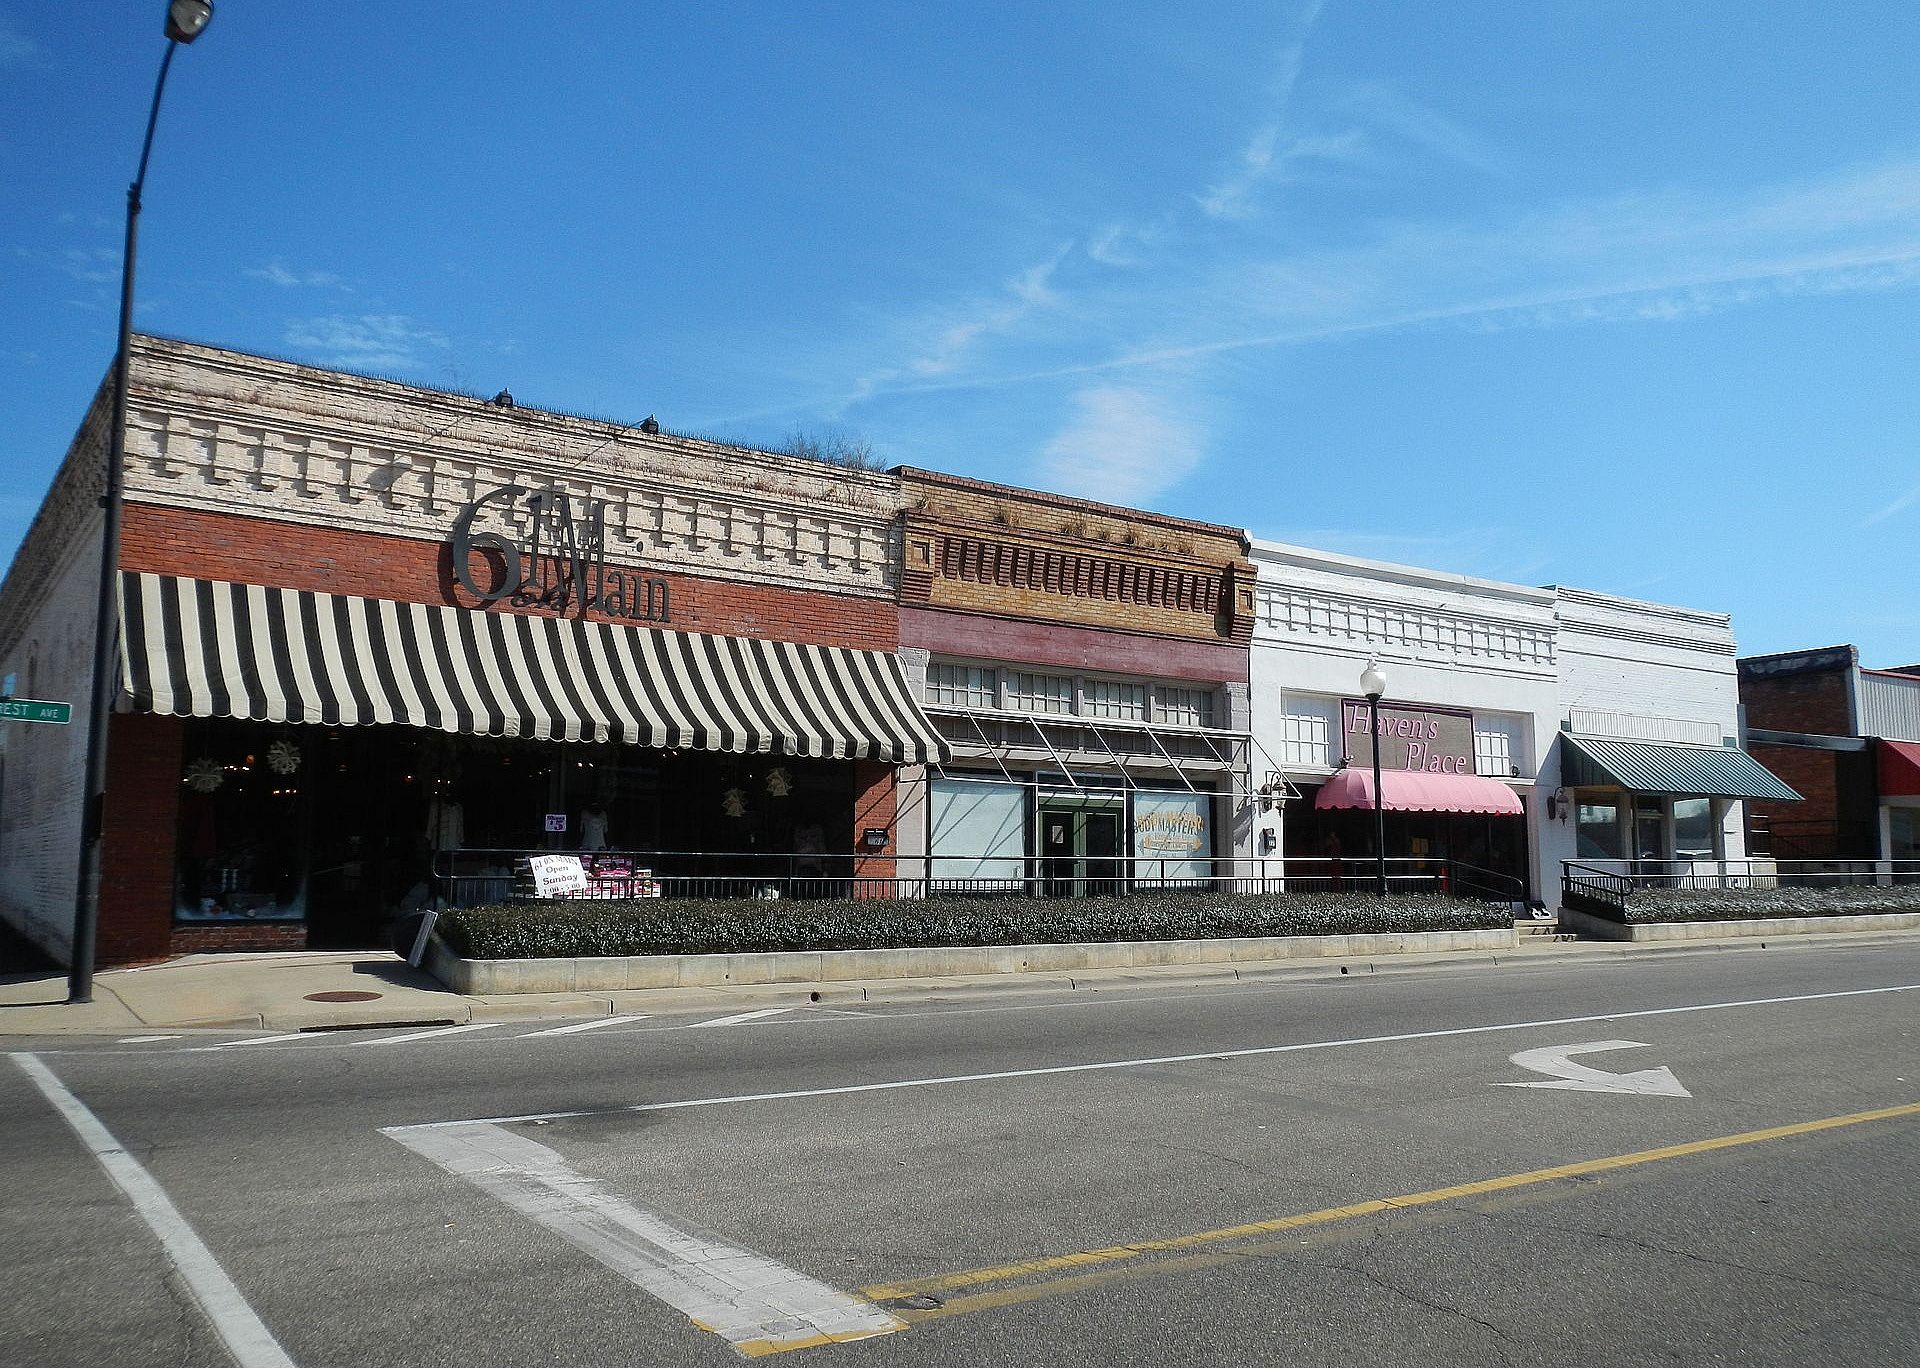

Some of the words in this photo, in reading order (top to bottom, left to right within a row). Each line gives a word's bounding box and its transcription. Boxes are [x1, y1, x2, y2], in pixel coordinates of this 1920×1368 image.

[452, 484, 543, 601] 61
[546, 494, 671, 623] Main
[40, 708, 59, 719] AVE
[1405, 741, 1467, 774] Place
[555, 855, 578, 866] MAIN
[545, 866, 569, 874] Open
[542, 874, 578, 886] Sunday
